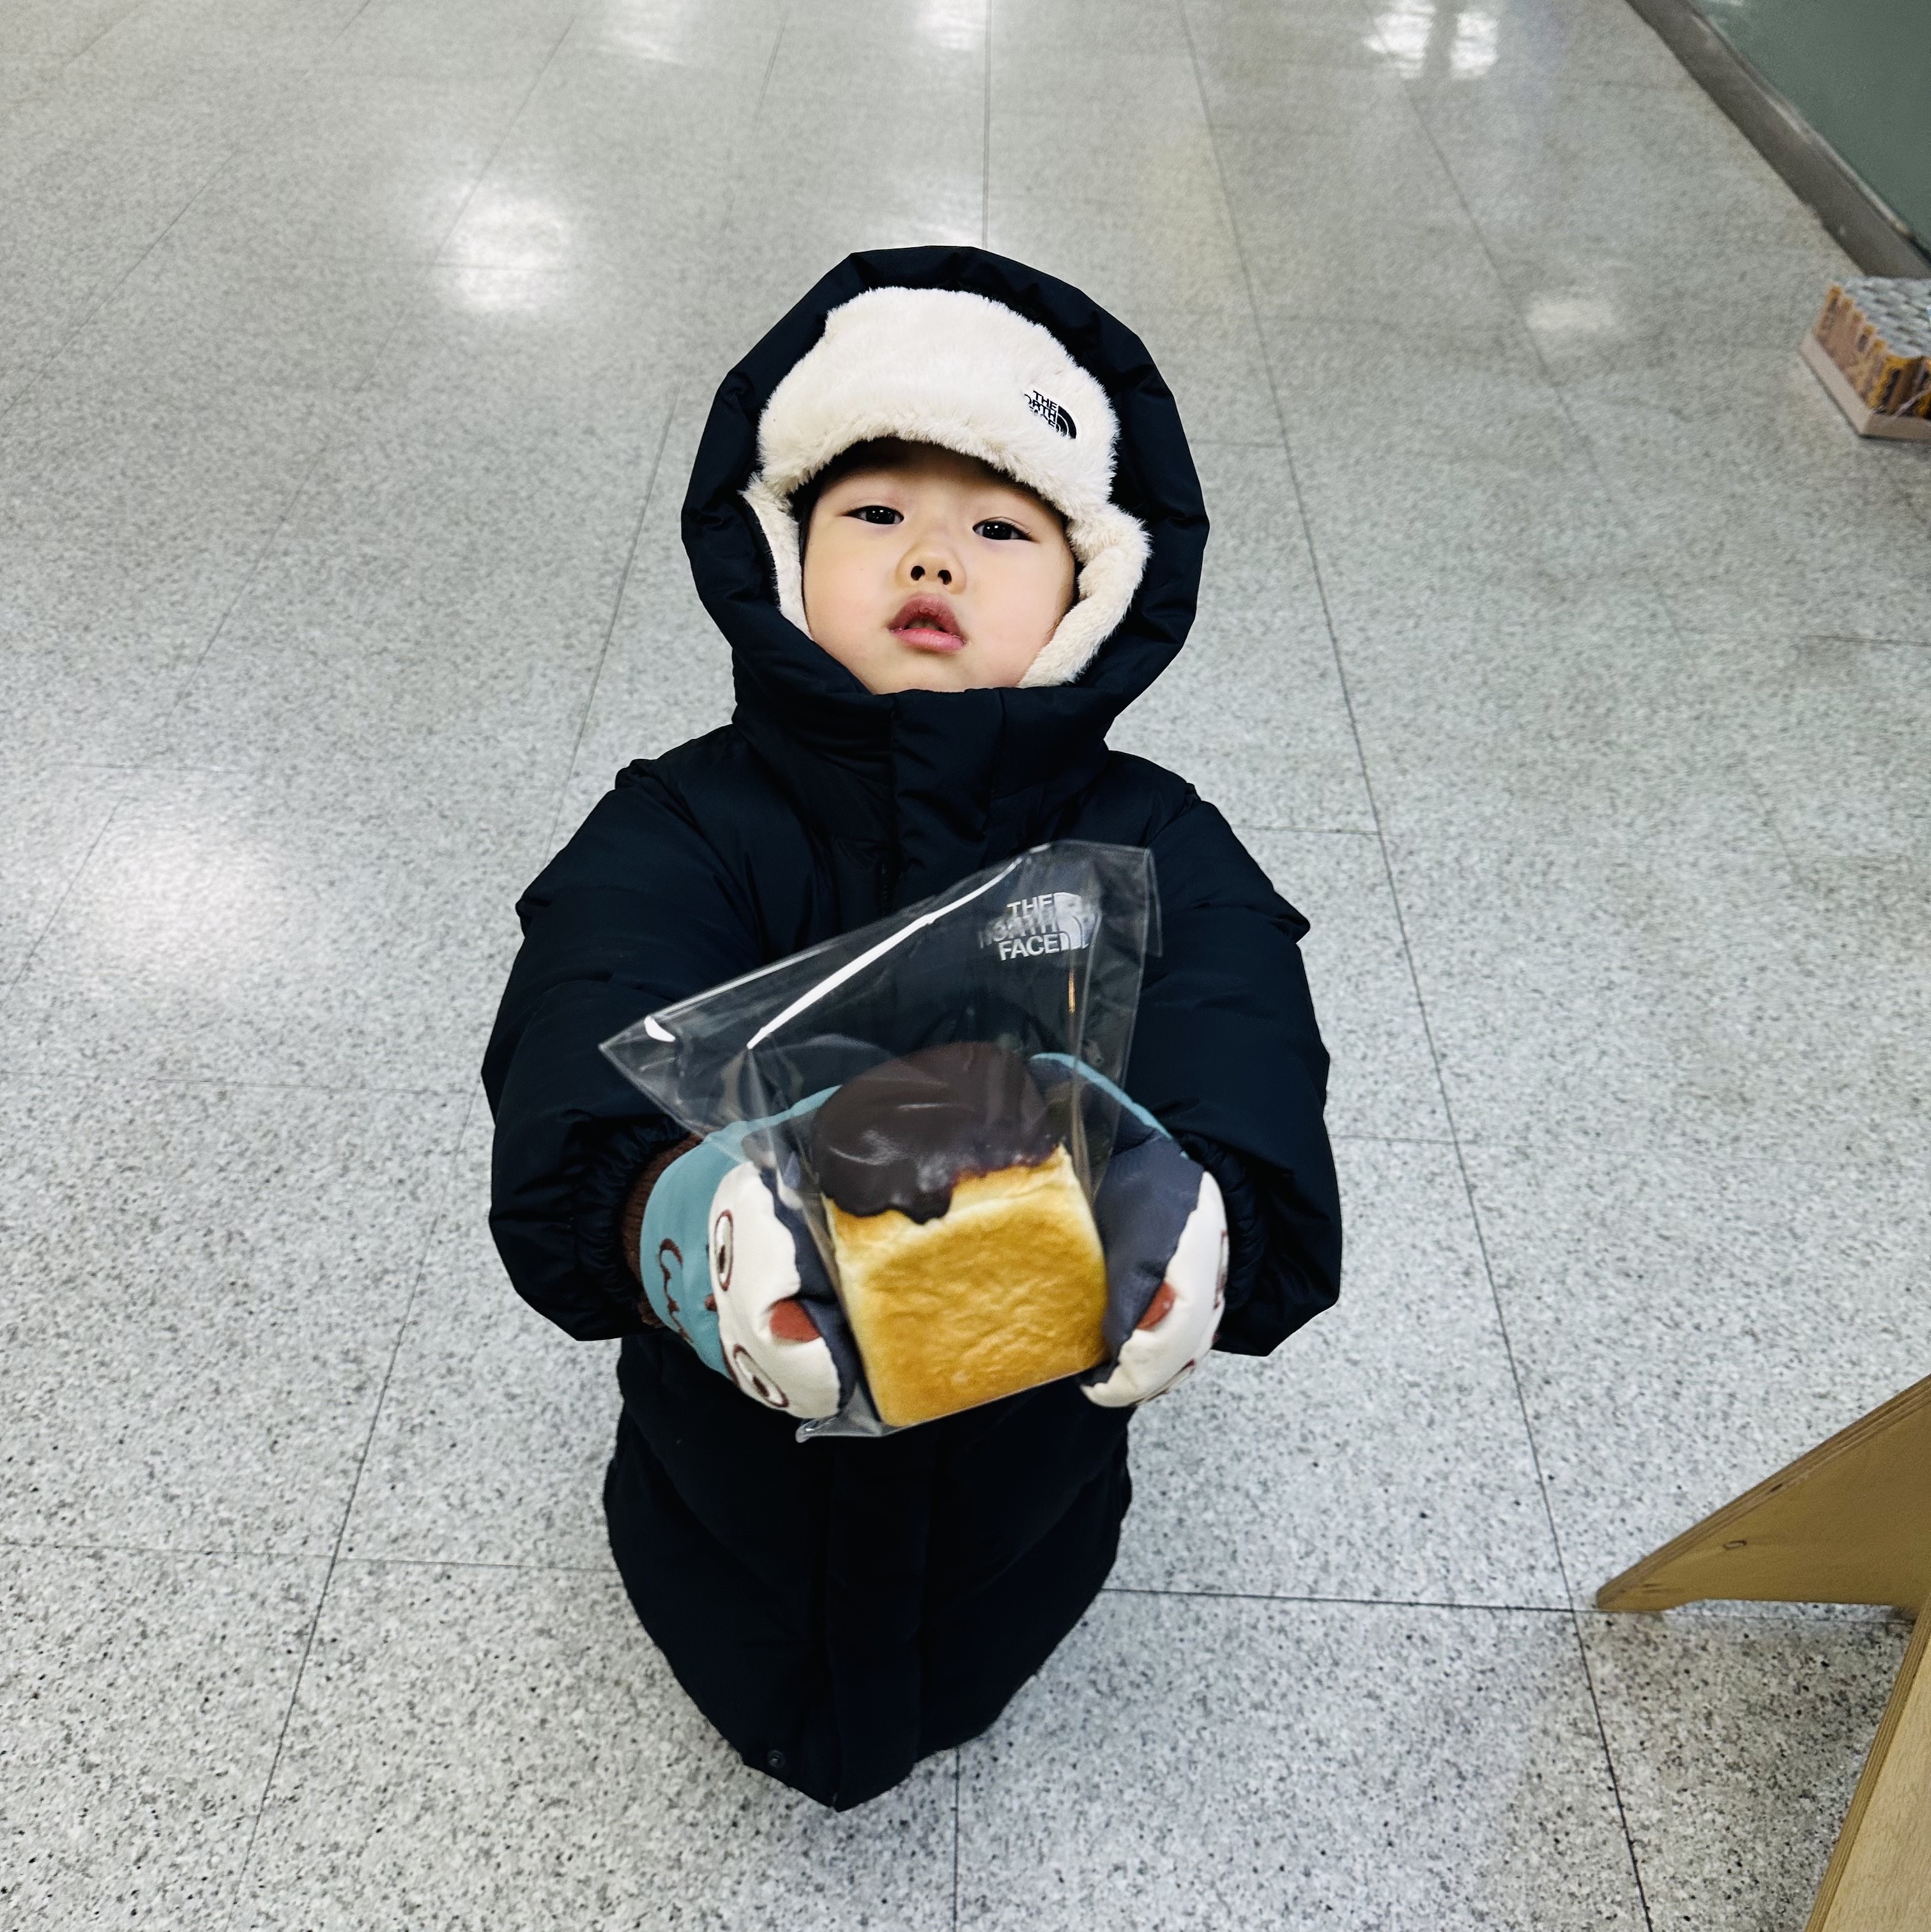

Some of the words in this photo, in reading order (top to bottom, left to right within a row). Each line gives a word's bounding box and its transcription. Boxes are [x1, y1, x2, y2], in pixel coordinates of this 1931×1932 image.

[1033, 390, 1057, 412] THE
[1007, 894, 1053, 918] THE
[998, 933, 1060, 961] FACE
